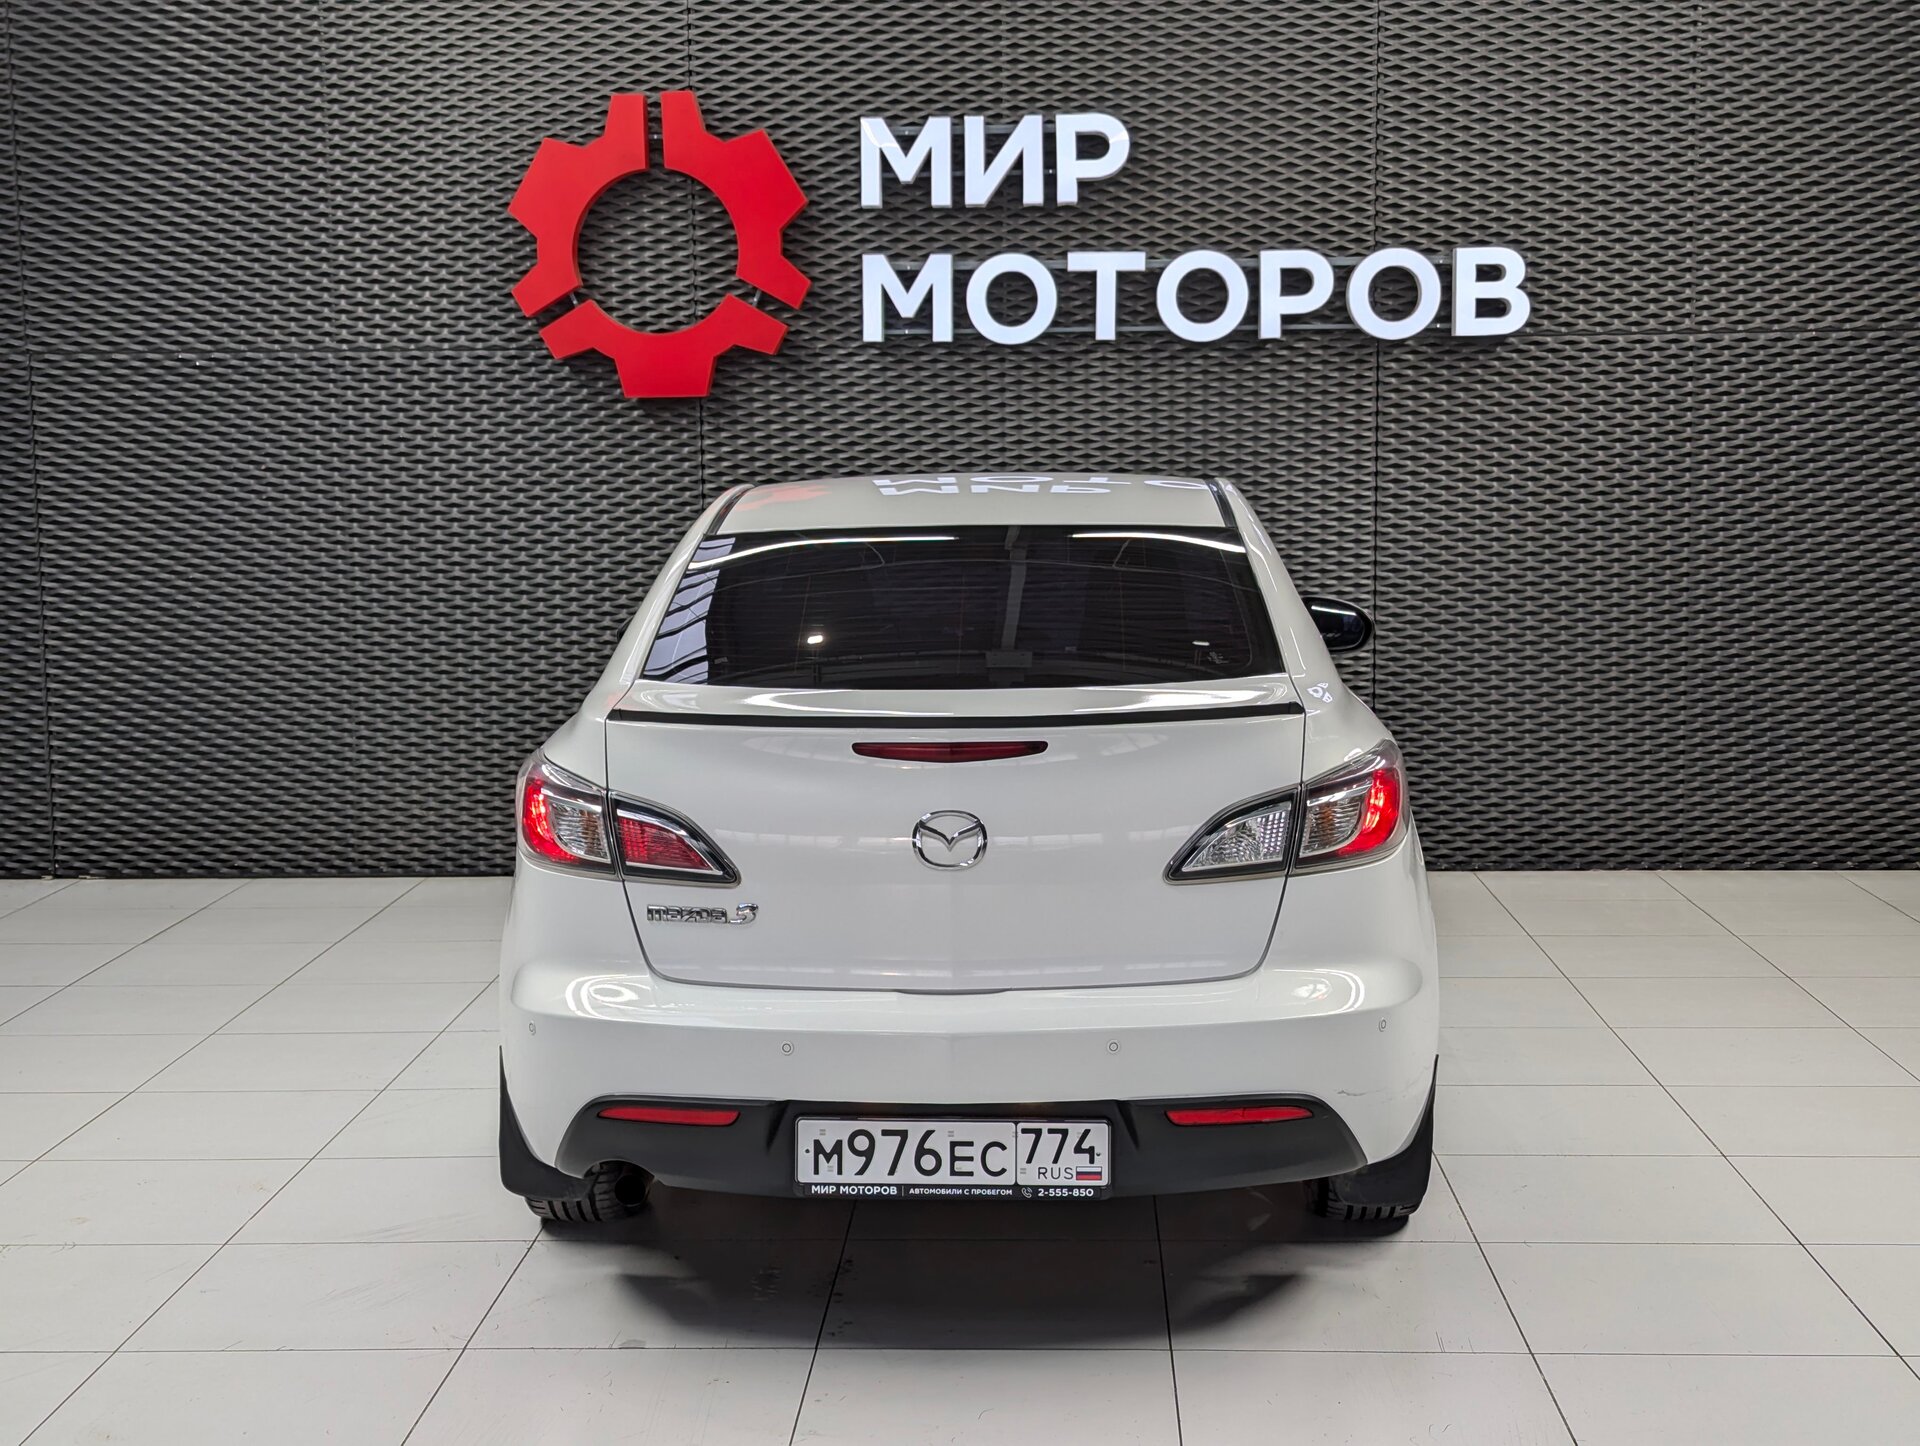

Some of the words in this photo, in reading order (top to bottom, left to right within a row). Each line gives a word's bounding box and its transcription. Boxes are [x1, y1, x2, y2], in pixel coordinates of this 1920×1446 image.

[859, 113, 1132, 209] МИР
[861, 246, 1532, 345] МОТОРОВ
[812, 1128, 1008, 1177] М976ЕС
[1020, 1128, 1096, 1165] 774
[1037, 1166, 1074, 1181] RUS
[811, 1184, 837, 1195] МИР
[839, 1185, 898, 1196] МОТОРОВ
[908, 1187, 963, 1196] АВТОМОБИЛИ
[963, 1188, 970, 1196] С
[970, 1188, 1013, 1196] ПРОБЕГОМ
[1037, 1188, 1095, 1197] 2-555-850
